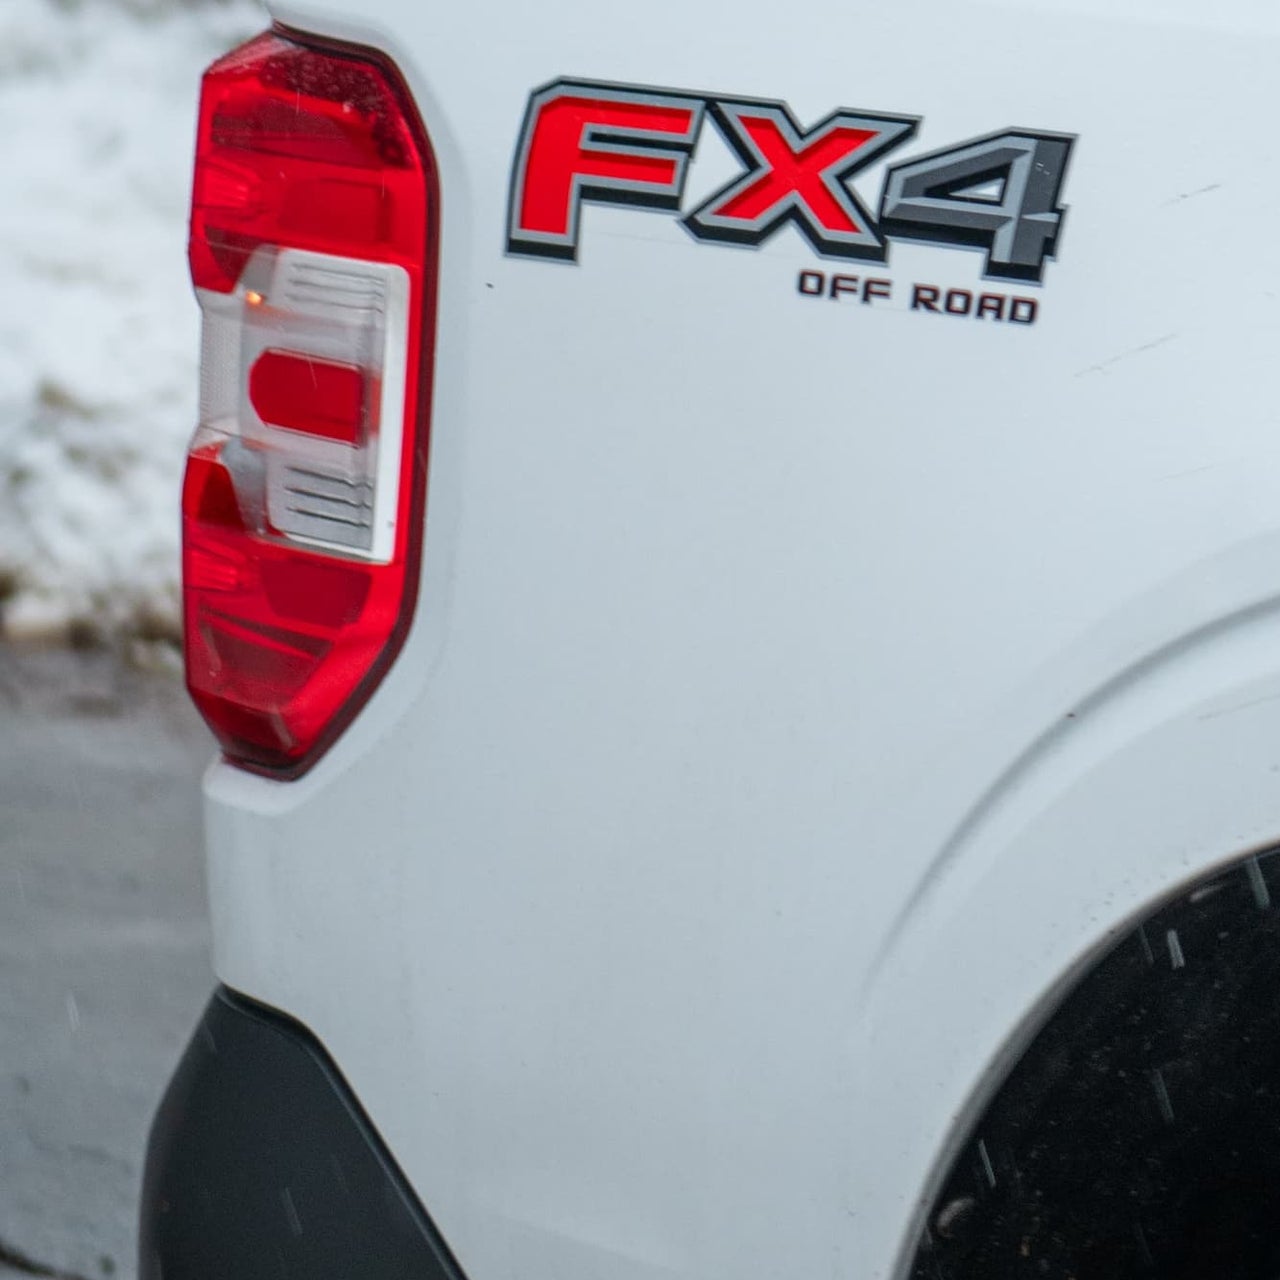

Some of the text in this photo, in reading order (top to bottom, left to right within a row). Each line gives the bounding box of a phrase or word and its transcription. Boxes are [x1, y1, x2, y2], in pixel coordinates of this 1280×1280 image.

[503, 76, 1080, 286] FX4
[797, 269, 1040, 325] OFF ROAD
